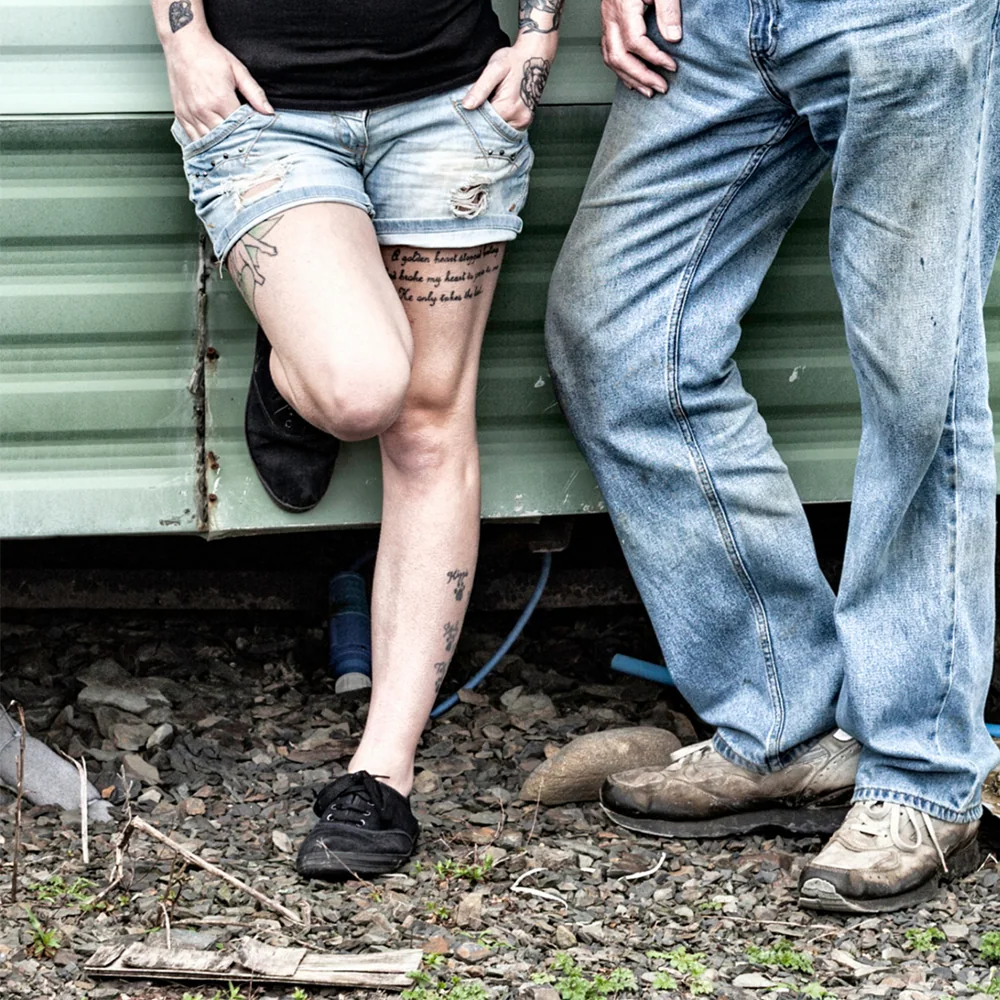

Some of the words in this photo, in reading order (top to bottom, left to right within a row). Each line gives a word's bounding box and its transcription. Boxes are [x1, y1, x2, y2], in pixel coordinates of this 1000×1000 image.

[401, 250, 430, 266] golden
[398, 268, 424, 283] broke
[427, 276, 442, 288] my
[444, 270, 466, 283] heart
[416, 290, 438, 307] only
[439, 290, 462, 302] takes
